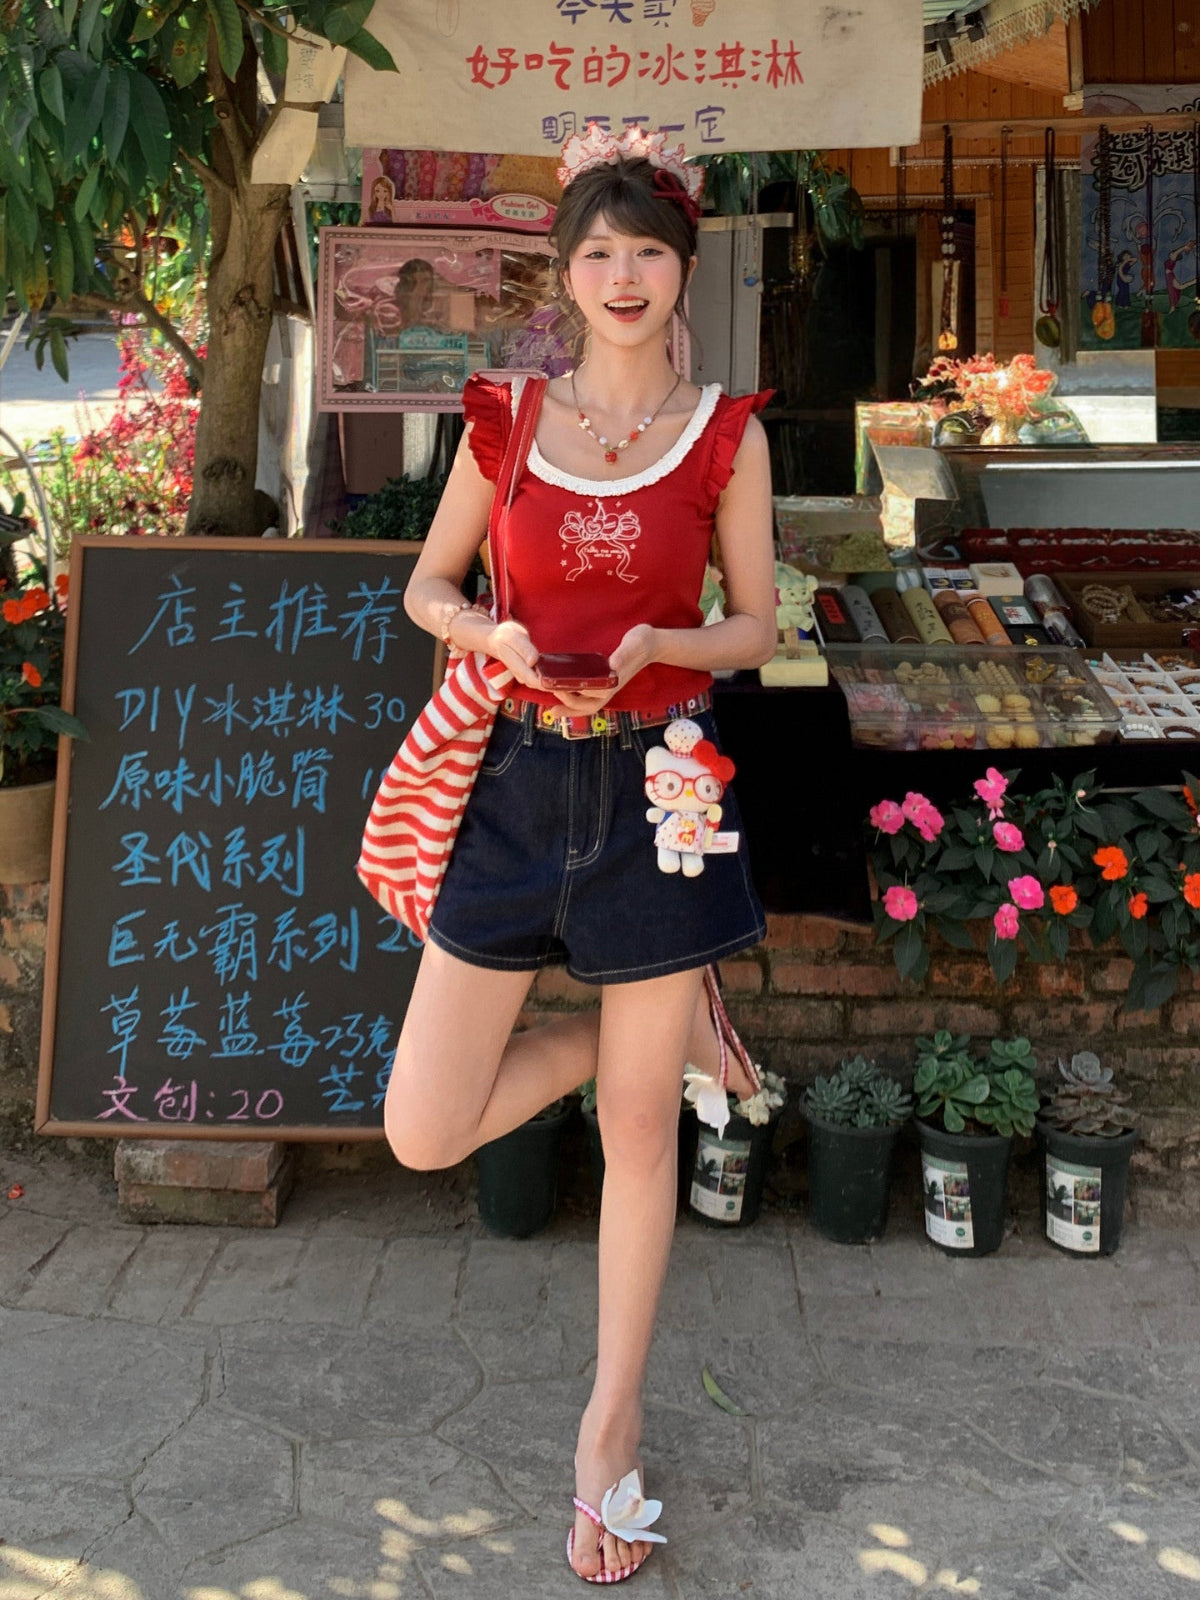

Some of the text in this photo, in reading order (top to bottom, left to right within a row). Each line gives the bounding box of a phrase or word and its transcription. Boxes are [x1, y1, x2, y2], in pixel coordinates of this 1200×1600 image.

[466, 39, 804, 90] 好吃的冰淇淋
[128, 574, 401, 665] 店主推荐
[363, 692, 406, 730] 30
[98, 747, 334, 814] 原味小脆筒
[111, 825, 305, 897] 圣代系列
[107, 902, 360, 986] 巨无霸系列
